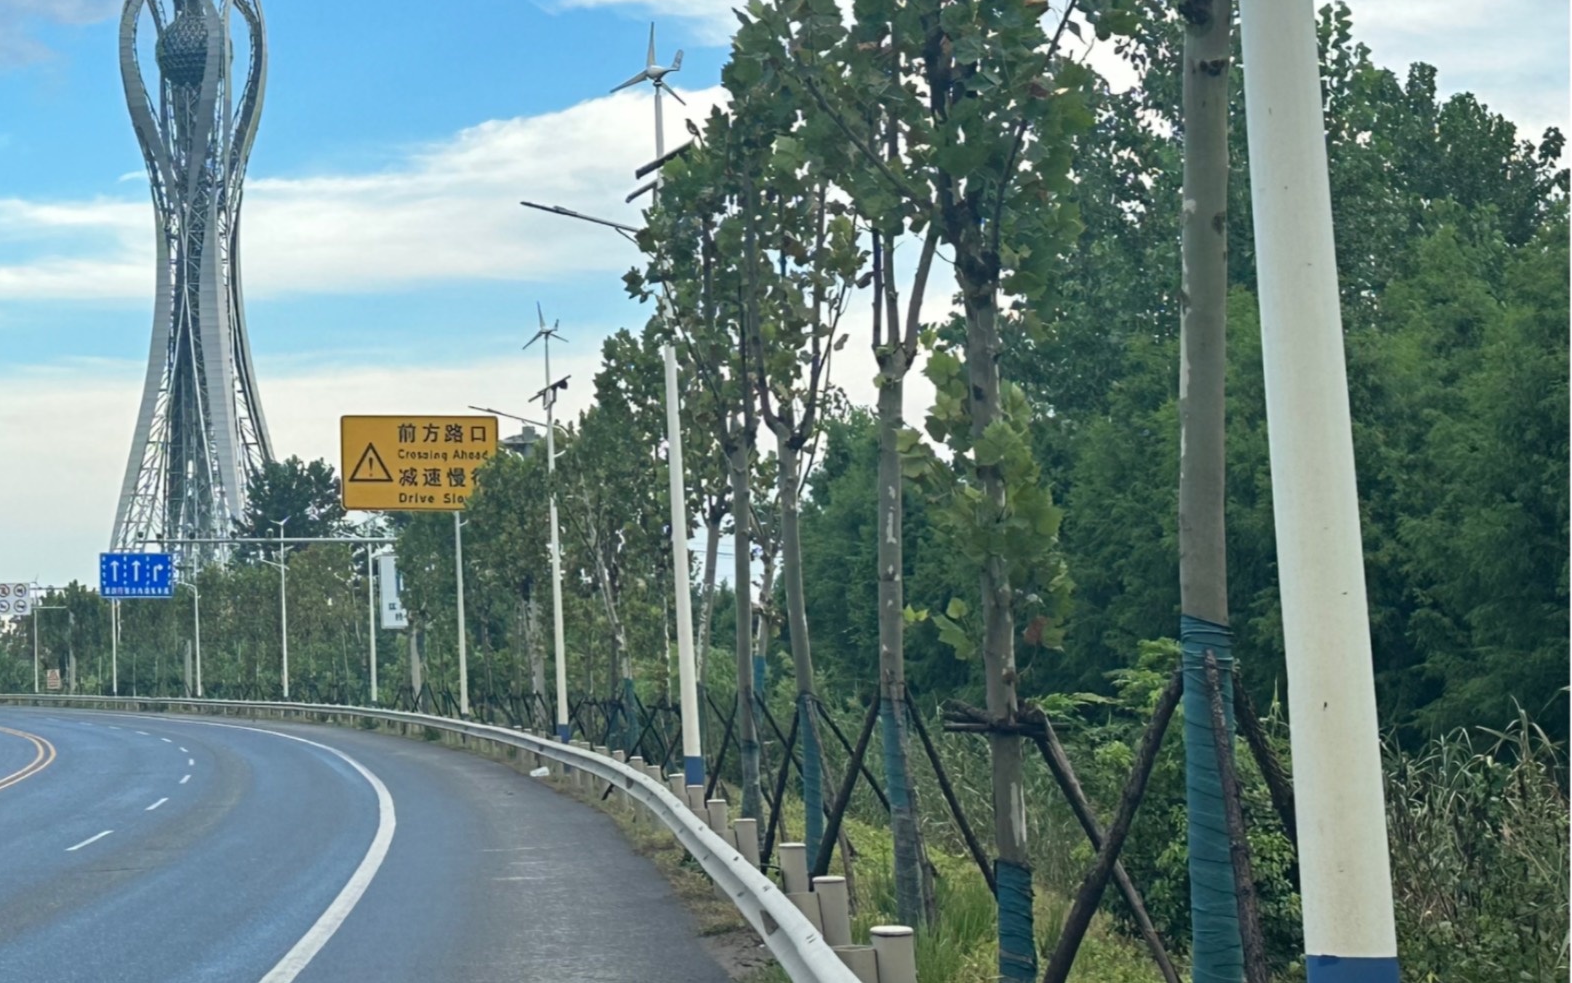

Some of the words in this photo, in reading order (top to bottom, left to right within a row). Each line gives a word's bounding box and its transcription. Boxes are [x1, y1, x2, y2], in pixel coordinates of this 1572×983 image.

[397, 423, 487, 443] 前方路口
[397, 449, 448, 462] Crossing
[453, 449, 489, 460] Ahead
[399, 492, 435, 504] Drive
[443, 492, 469, 504] Slo
